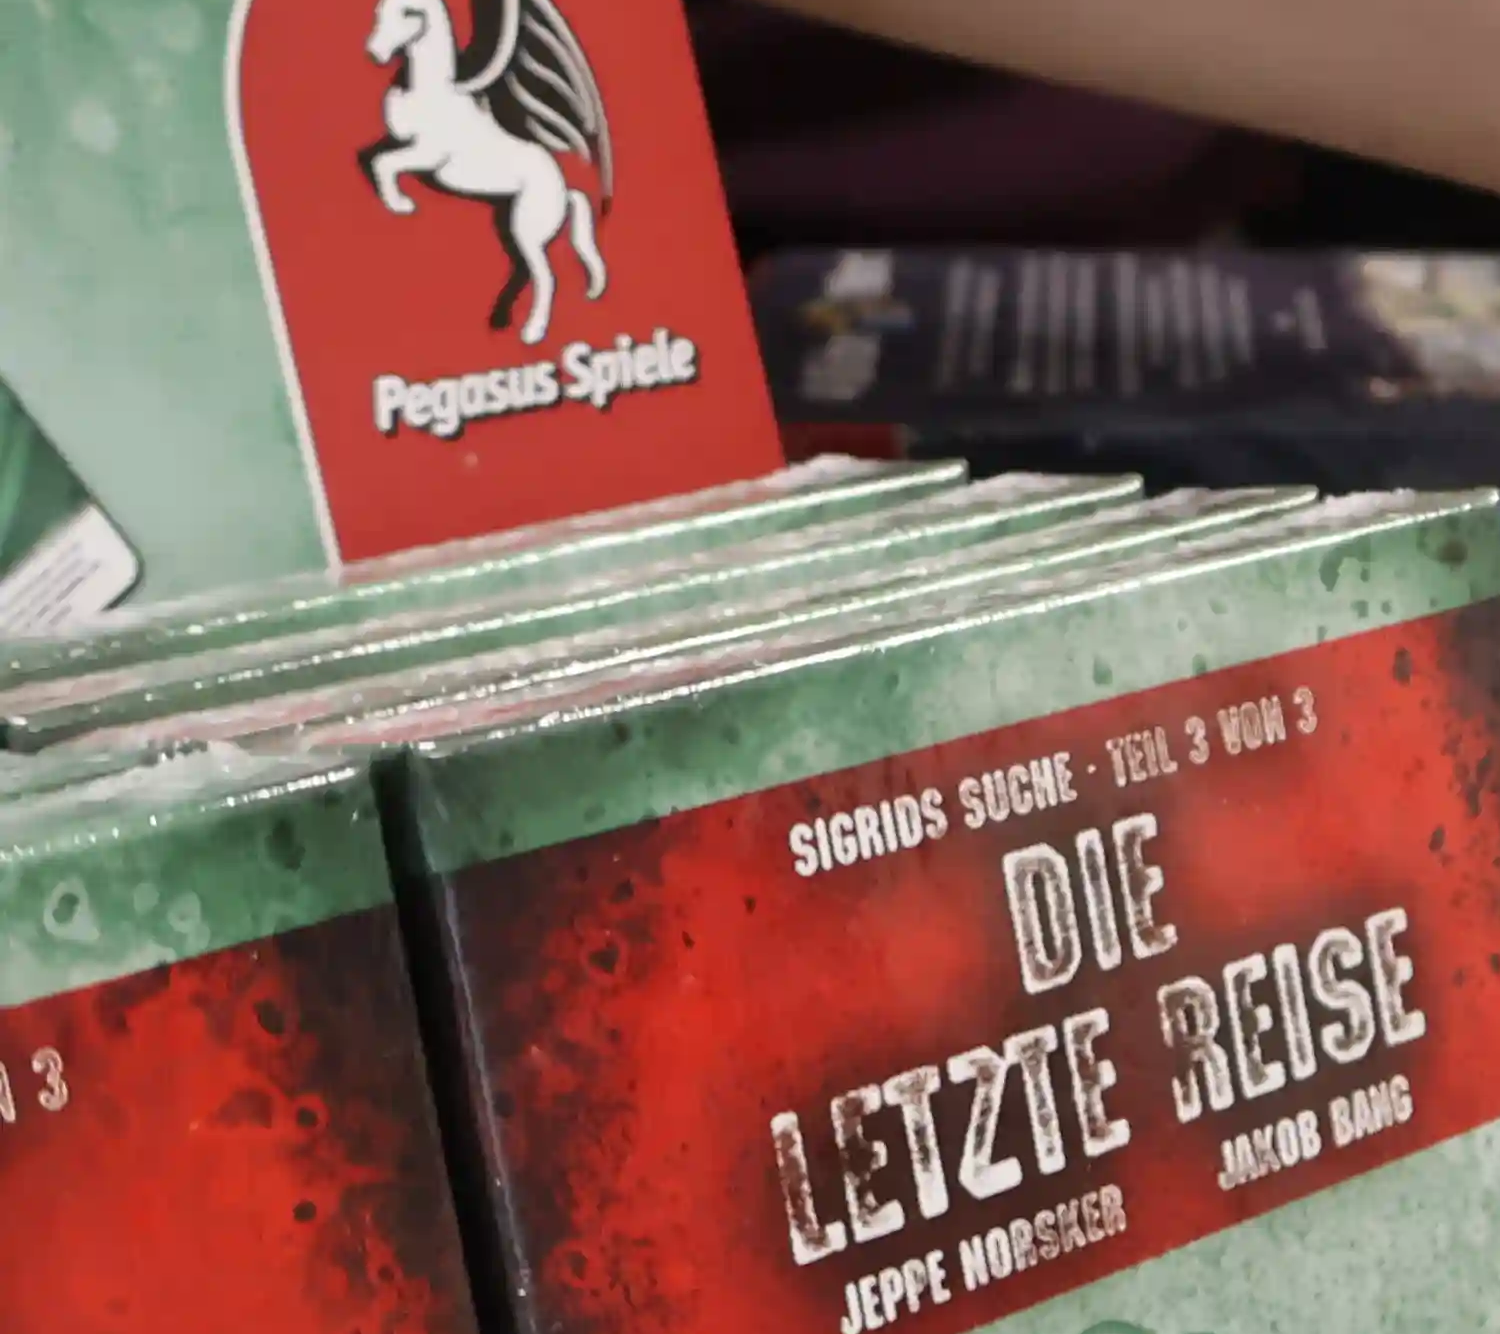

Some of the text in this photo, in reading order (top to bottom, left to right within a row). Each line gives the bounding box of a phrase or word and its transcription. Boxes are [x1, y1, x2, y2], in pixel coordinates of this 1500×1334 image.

[372, 326, 698, 440] Pegasus Spiele
[789, 687, 1319, 878] SIGRIDS SUCHE TEIL 3 VON 3
[1002, 813, 1178, 995] DIE
[31, 1046, 69, 1111] 3
[769, 908, 1427, 1266] LETZTE REISE
[1218, 1074, 1414, 1191] JAKOB BANG
[959, 1184, 1128, 1292] NORSKER
